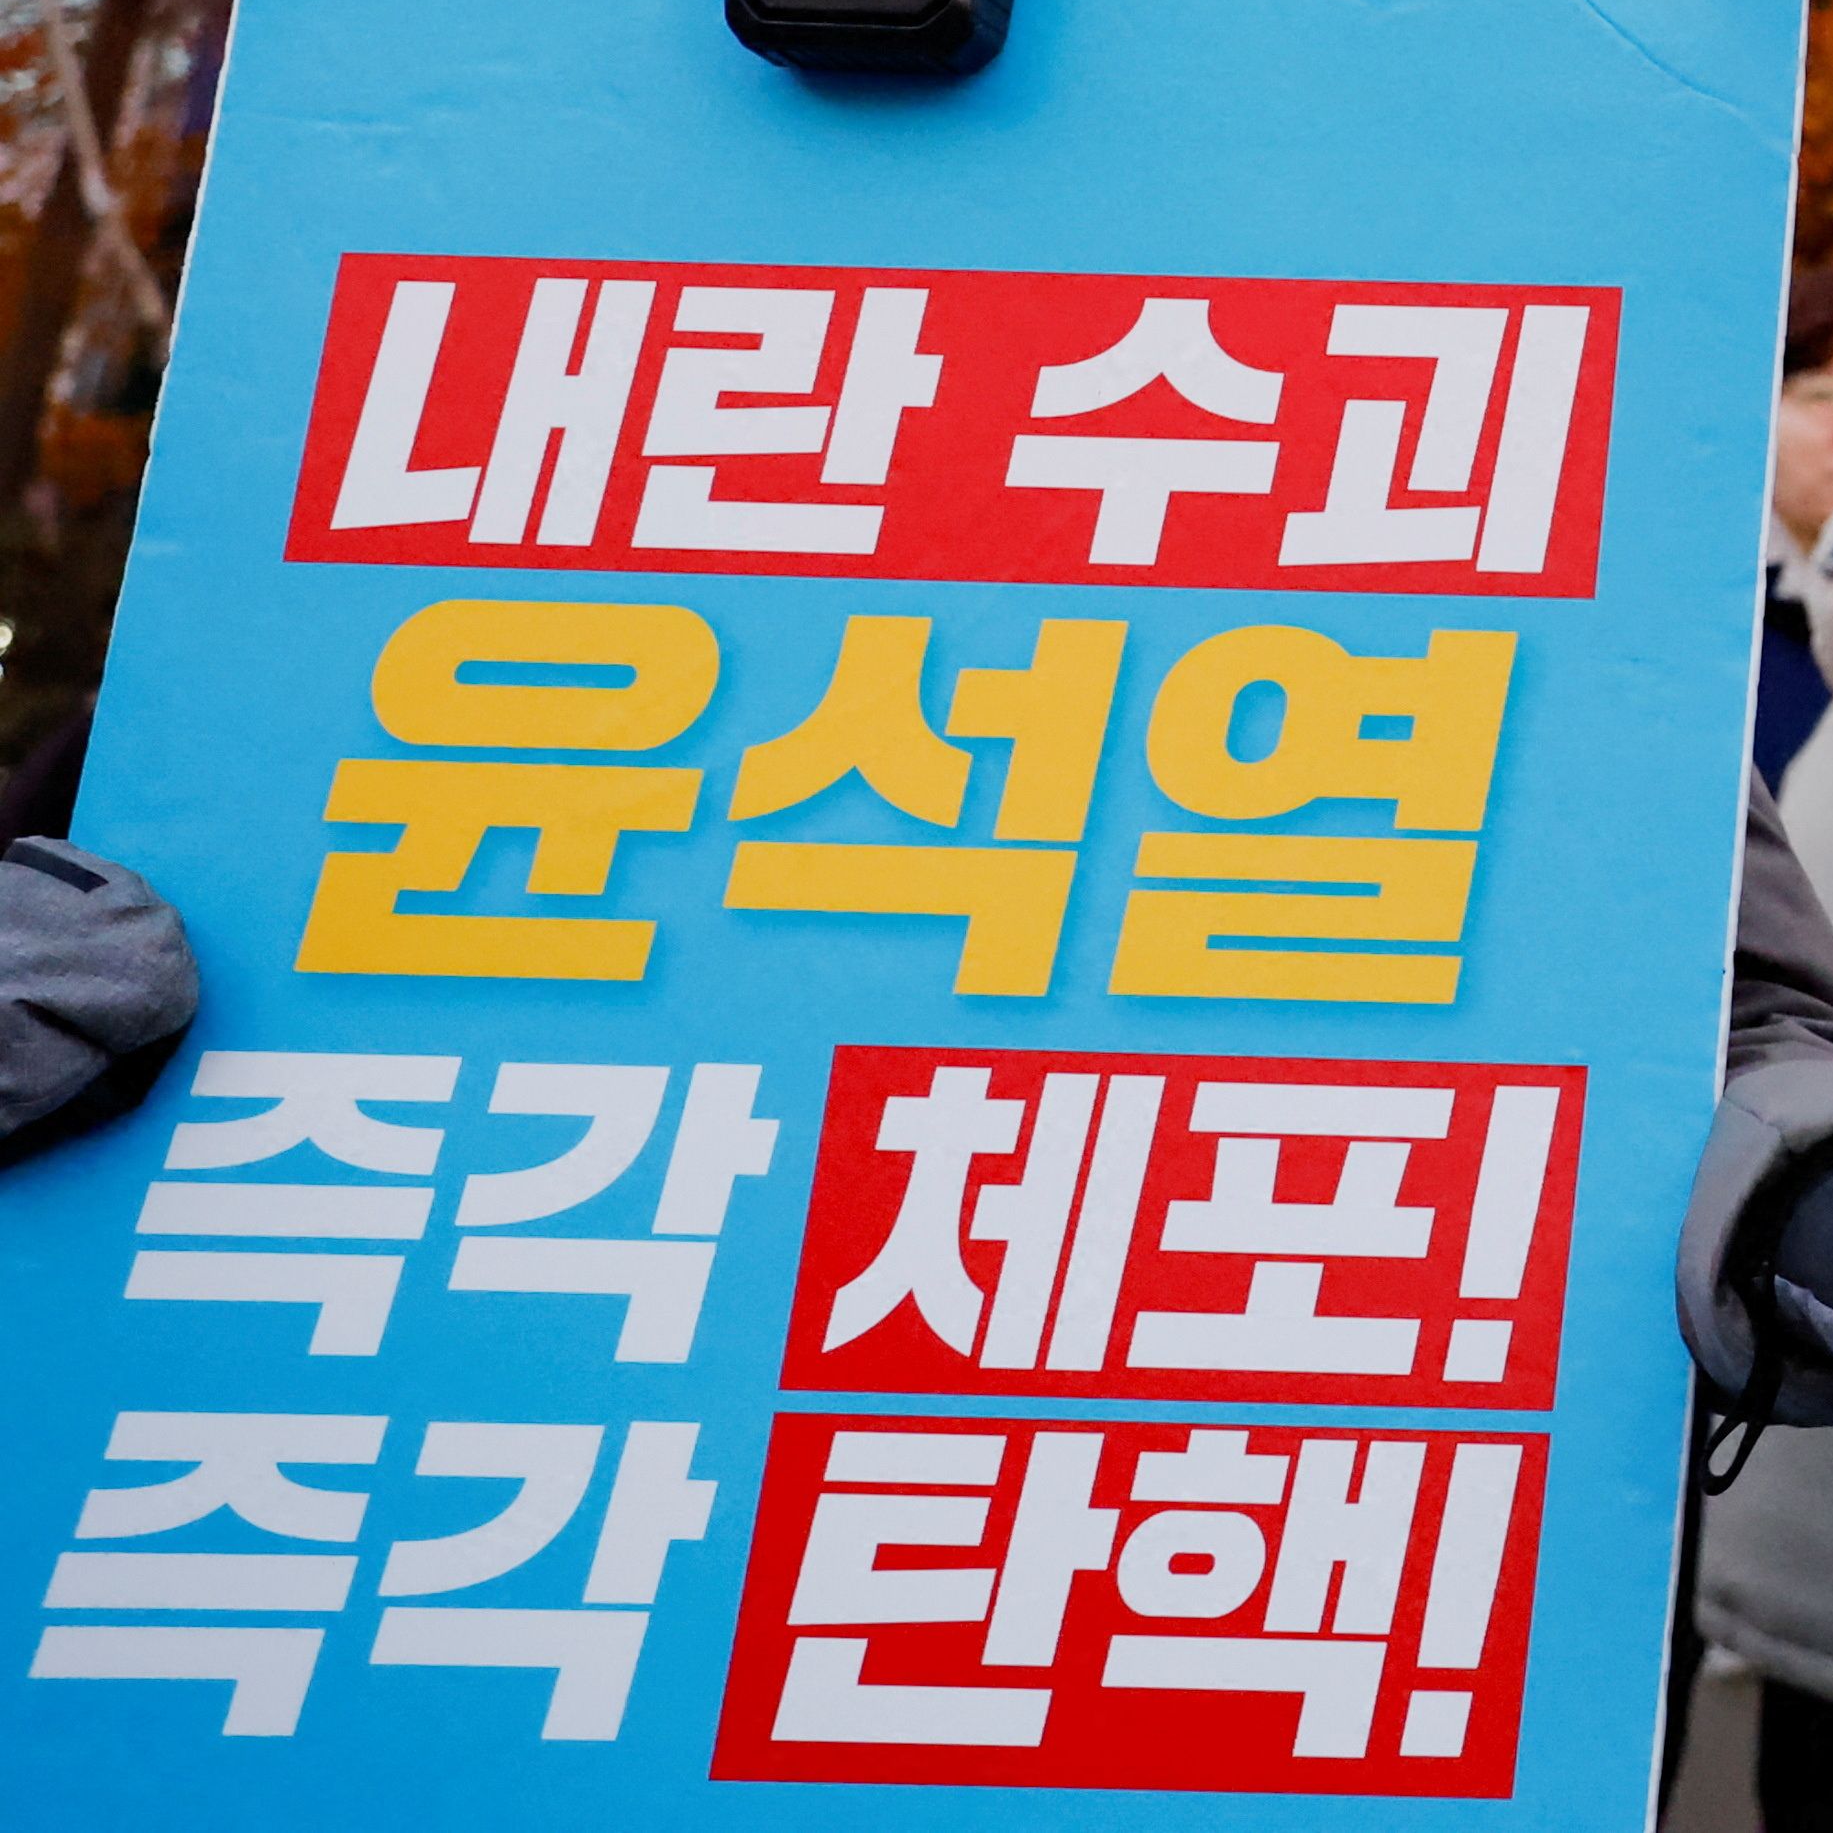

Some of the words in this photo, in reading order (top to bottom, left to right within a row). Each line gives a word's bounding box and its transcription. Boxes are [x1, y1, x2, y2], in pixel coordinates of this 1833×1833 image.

[330, 277, 944, 555] 내란
[1005, 296, 1590, 575] 수괴
[292, 597, 1520, 1006] 윤석열
[122, 1049, 780, 1365] 즉각
[821, 1064, 1562, 1385] 체포!
[30, 1409, 720, 1742] 즉각
[768, 1427, 1527, 1760] 탄핵!
